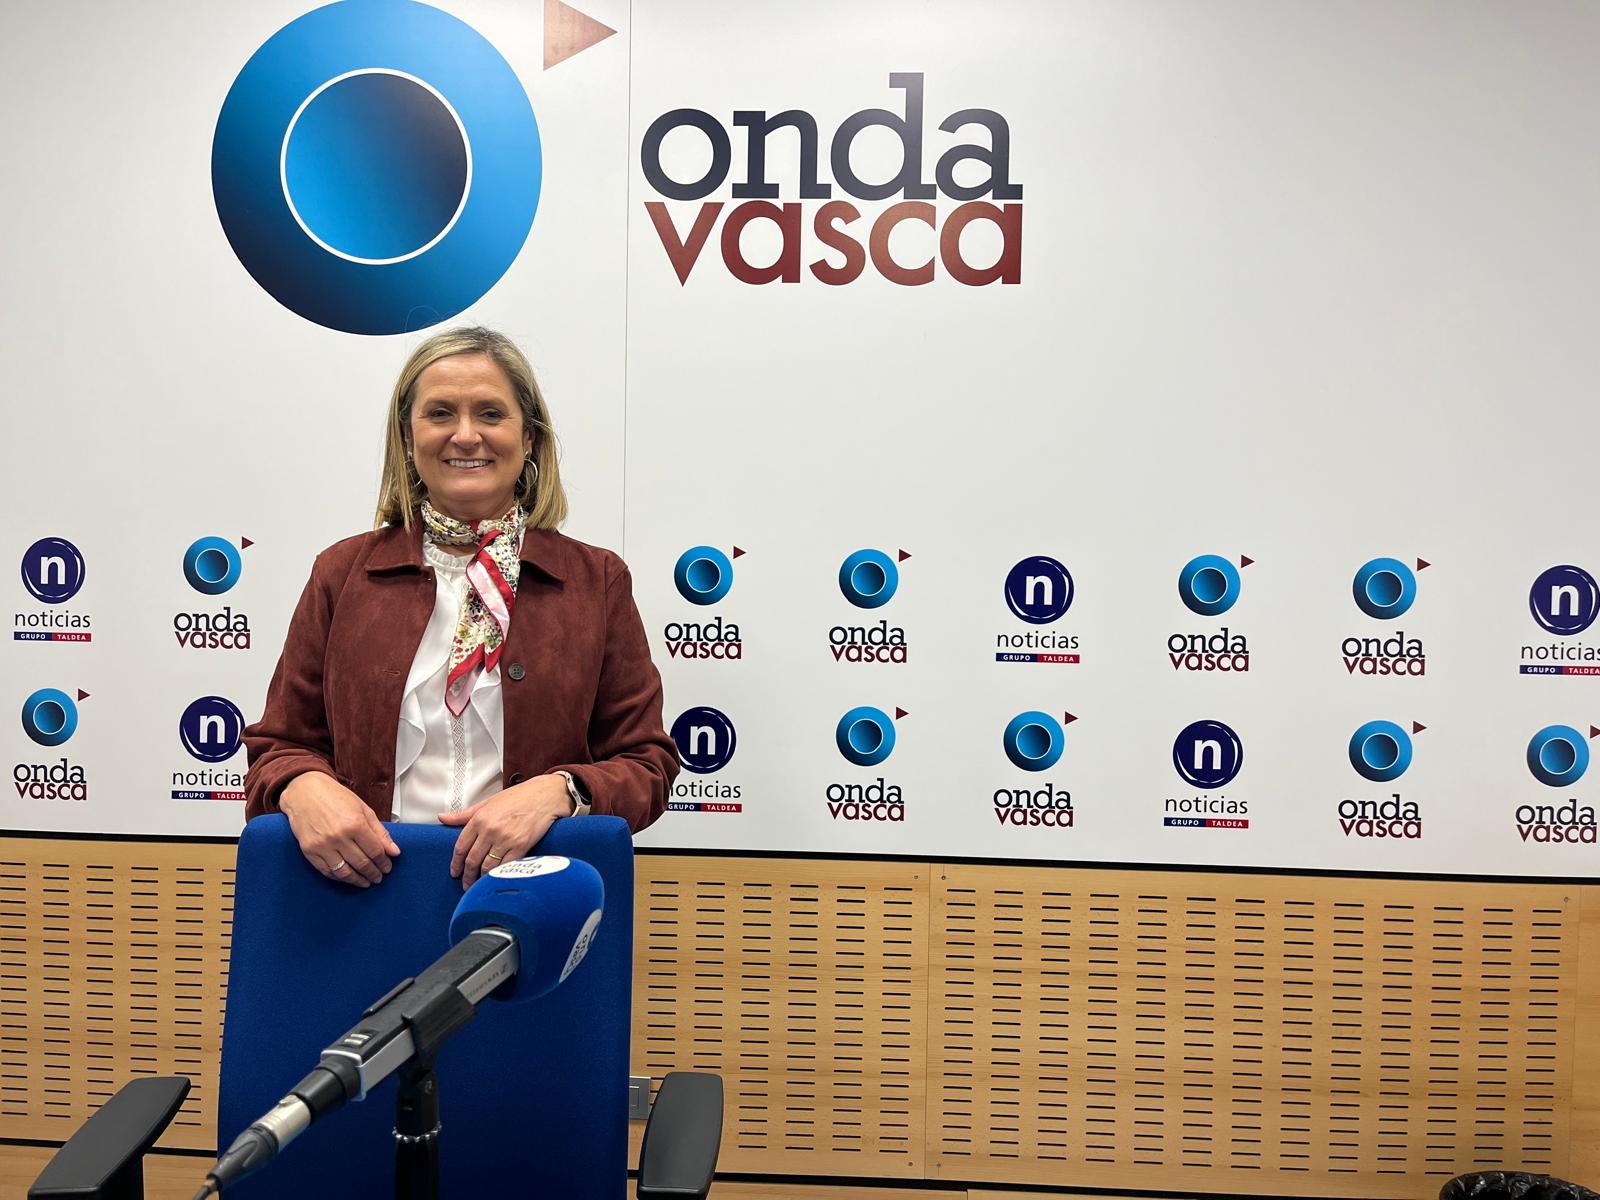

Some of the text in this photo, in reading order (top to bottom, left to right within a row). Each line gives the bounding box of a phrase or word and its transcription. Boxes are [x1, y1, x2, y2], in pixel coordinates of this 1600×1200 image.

[640, 72, 1023, 201] onda
[643, 200, 1023, 287] vasca
[40, 555, 66, 585] n
[1025, 575, 1053, 606] n
[1551, 584, 1579, 616] n
[15, 609, 91, 628] noticias
[173, 606, 250, 632] onda
[664, 616, 742, 642] onda
[175, 631, 251, 650] vasca
[828, 620, 907, 646] onda
[997, 631, 1079, 649] noticias
[1167, 627, 1249, 654] onda
[1341, 631, 1425, 658] onda
[665, 641, 742, 660] vasca
[830, 644, 907, 664] vasca
[1168, 652, 1249, 672] vasca
[1342, 656, 1425, 676] vasca
[1527, 666, 1556, 674] GRUPO
[199, 714, 226, 744] n
[689, 725, 716, 755] n
[1194, 739, 1222, 770] n
[13, 758, 87, 784] onda
[172, 769, 246, 787] noticia
[14, 782, 87, 801] vasca
[826, 778, 904, 804] onda
[993, 783, 1073, 810] onda
[827, 802, 904, 821] vasca
[994, 807, 1073, 827] vasca
[1165, 795, 1248, 814] noticias
[1338, 794, 1422, 821] onda
[1515, 799, 1597, 826] onda
[1212, 820, 1243, 828] TALDEA
[1339, 818, 1422, 839] vasca
[1516, 824, 1597, 843] vasca
